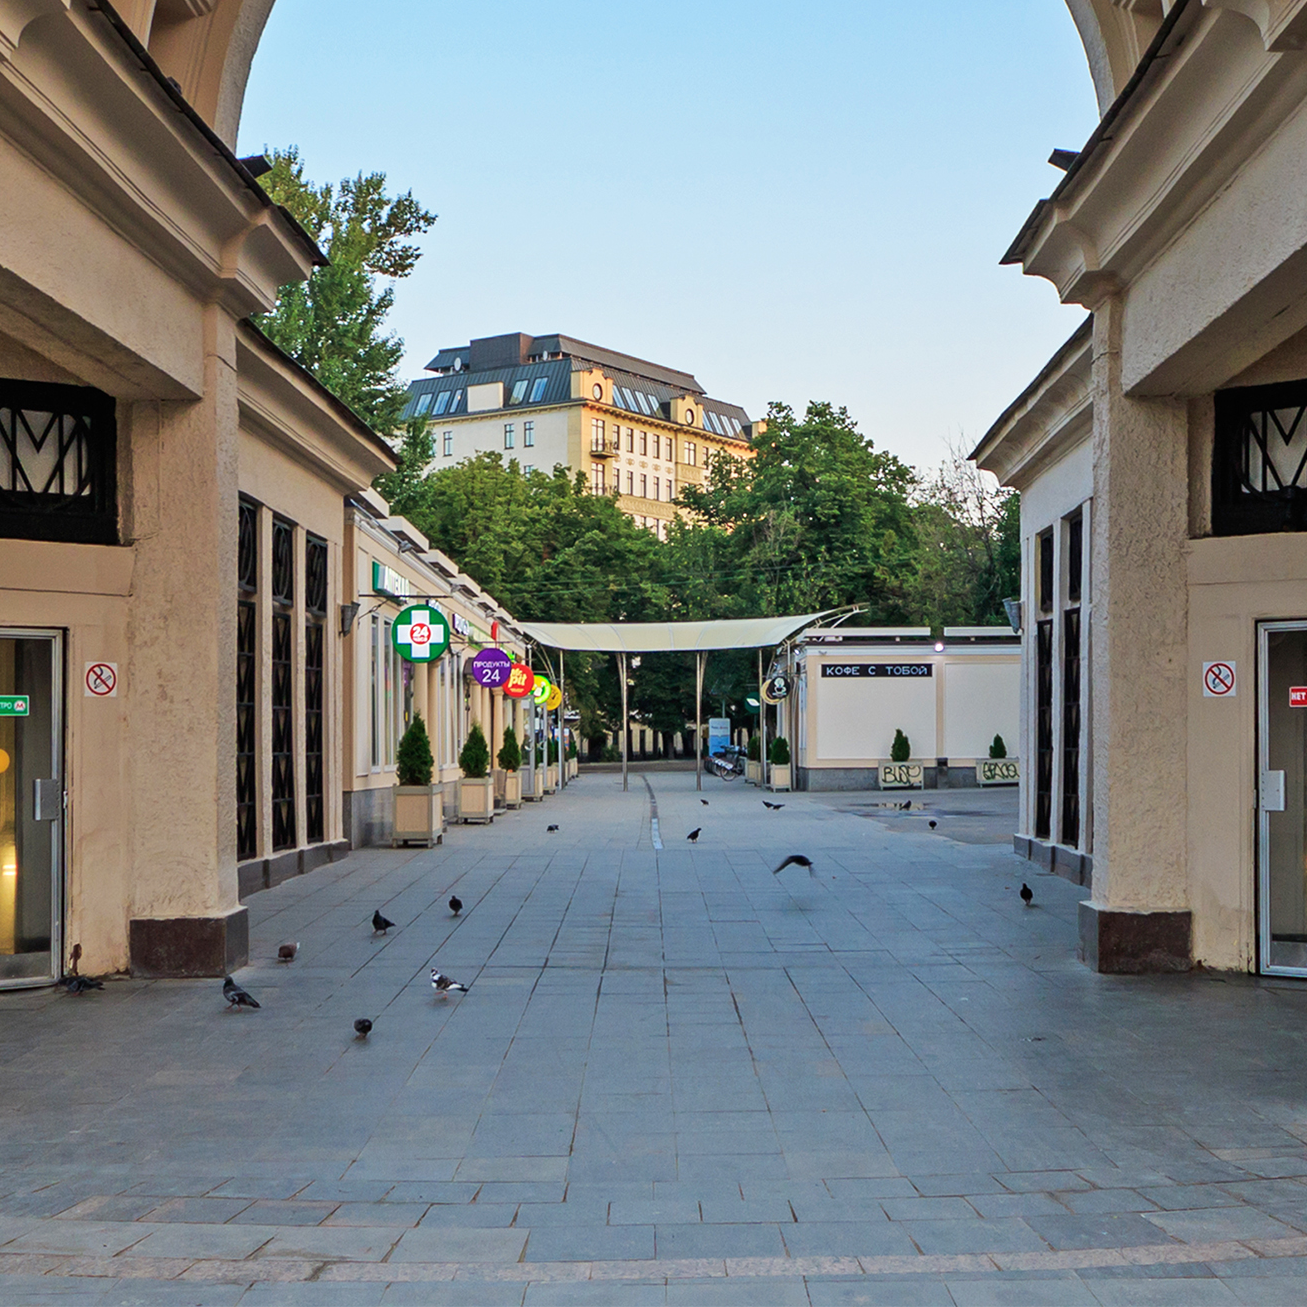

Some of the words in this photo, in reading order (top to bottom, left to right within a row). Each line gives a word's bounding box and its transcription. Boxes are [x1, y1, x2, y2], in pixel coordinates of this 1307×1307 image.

[412, 625, 429, 637] 24
[473, 660, 511, 669] ПРОДУКТЫ
[482, 669, 500, 683] 24
[826, 666, 860, 676] КОФЕ
[868, 666, 876, 676] С
[887, 665, 928, 676] ТОБОЙ
[1291, 691, 1306, 701] НЕТ
